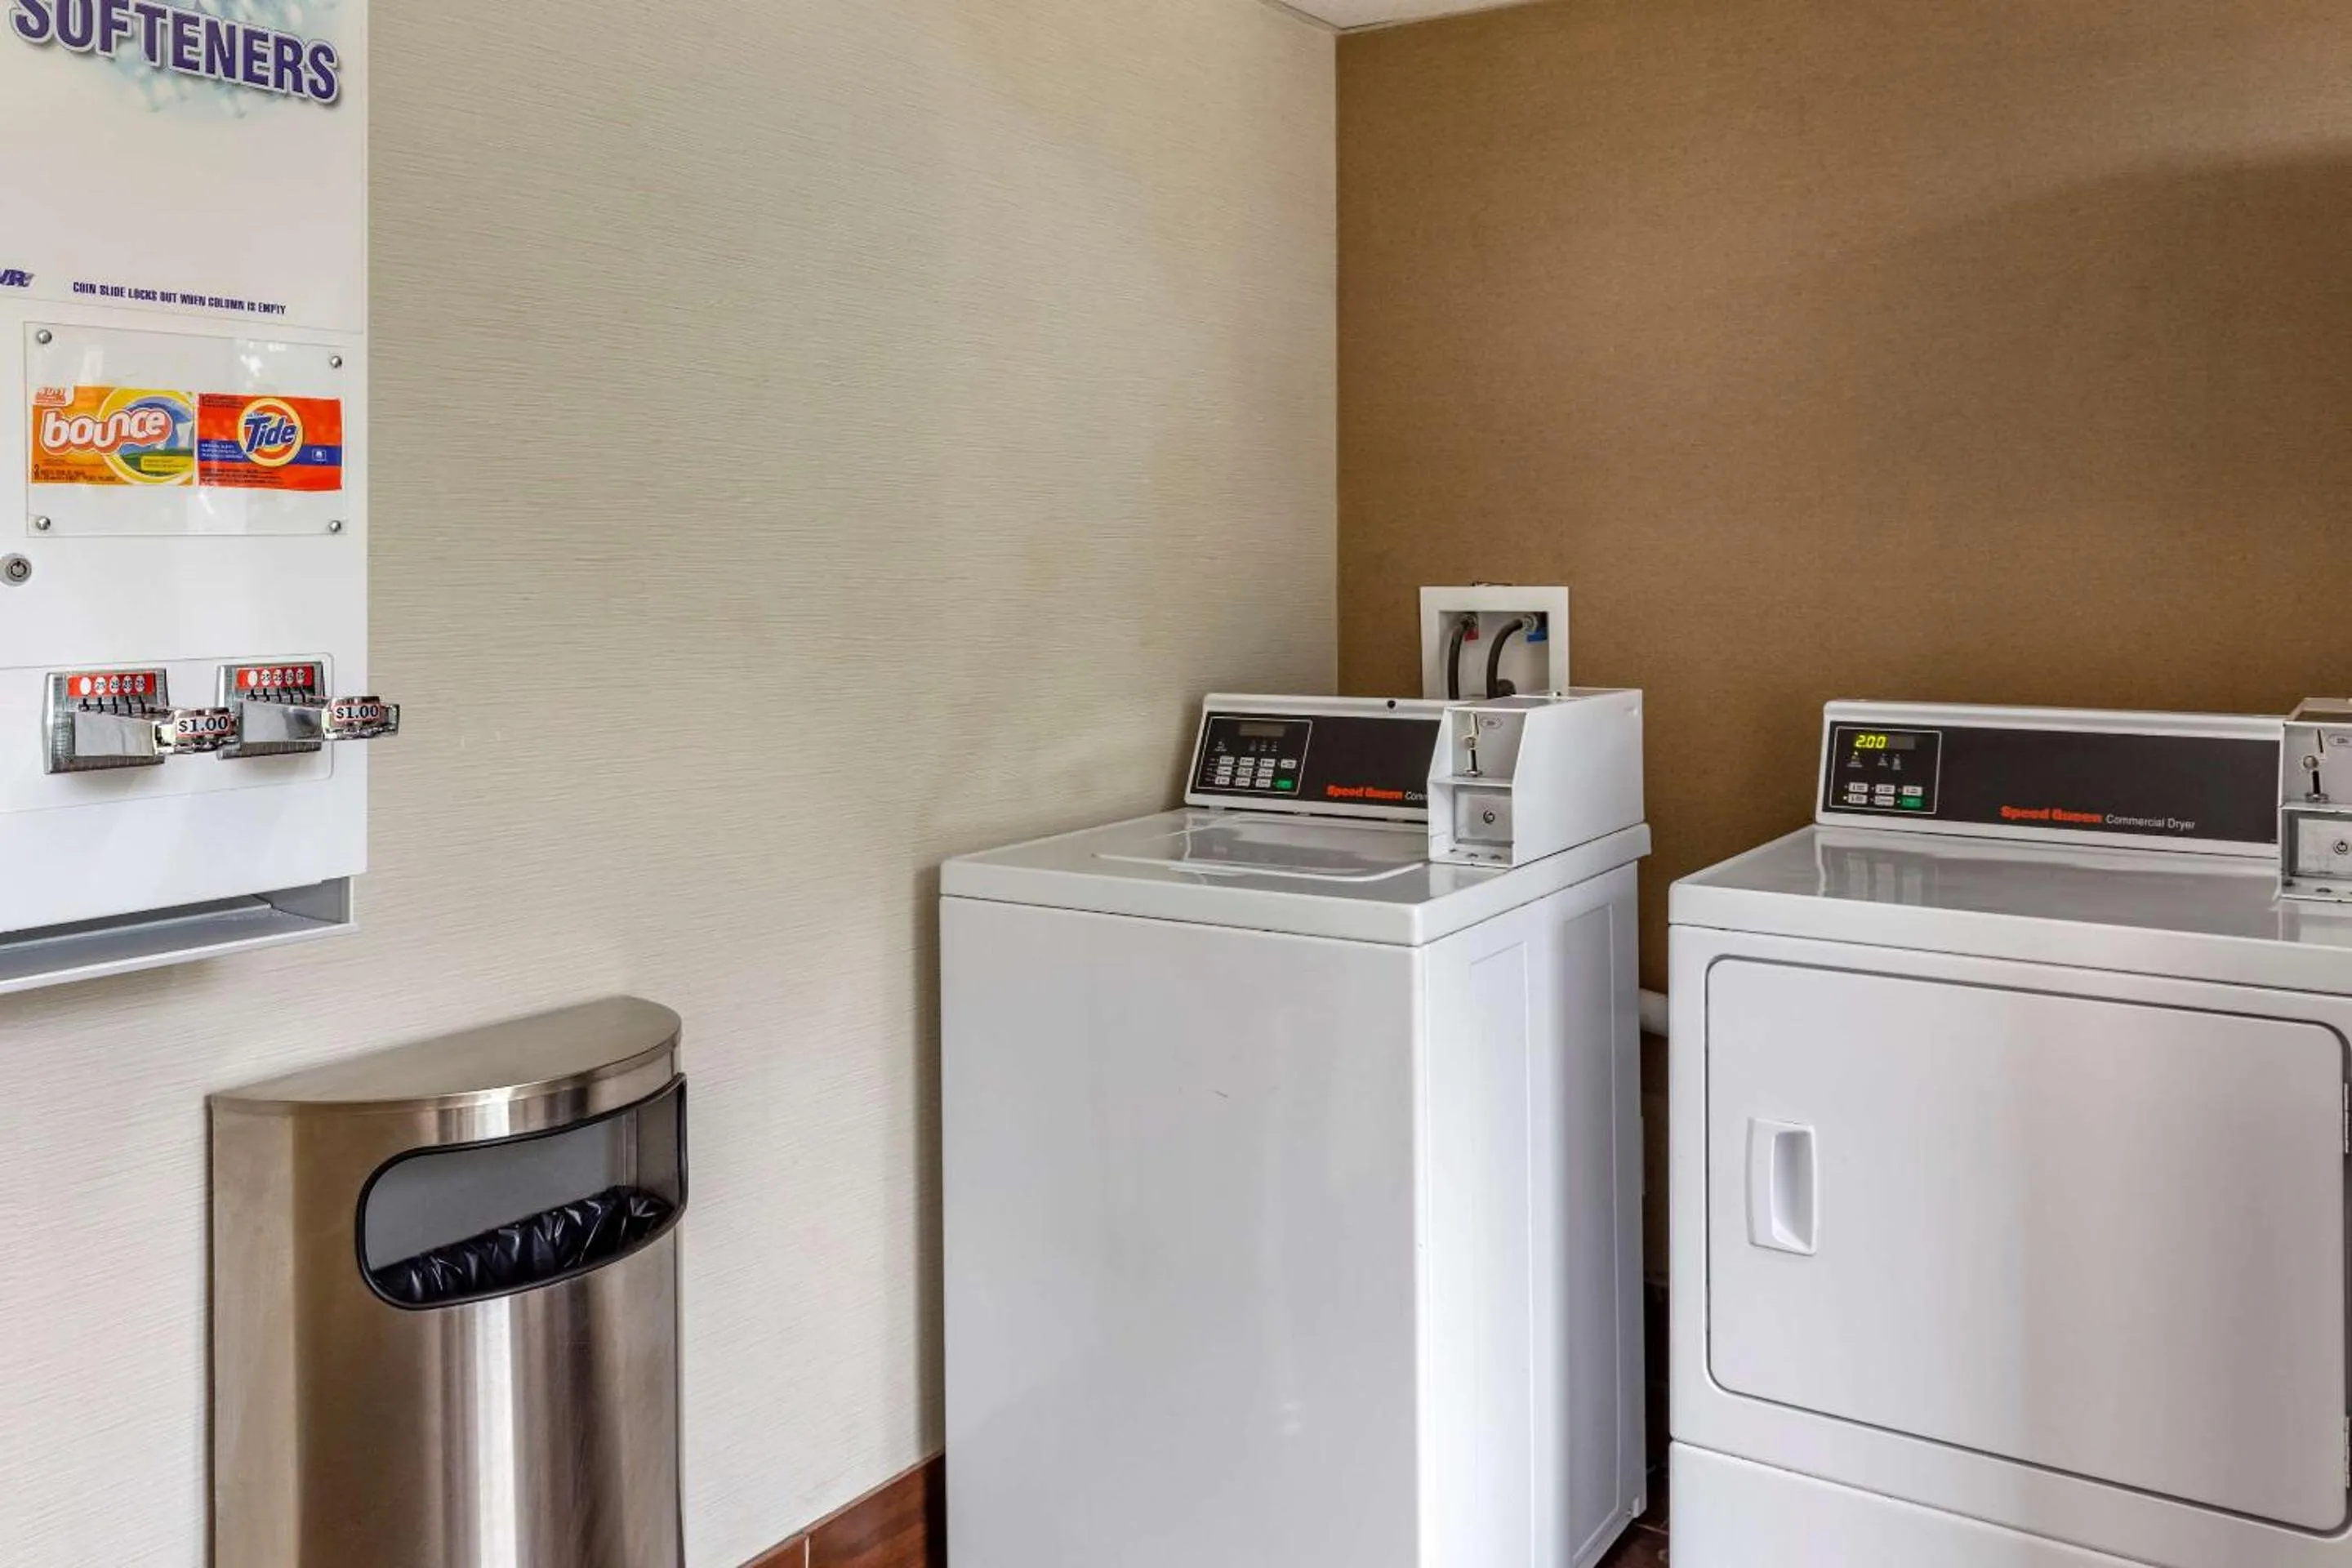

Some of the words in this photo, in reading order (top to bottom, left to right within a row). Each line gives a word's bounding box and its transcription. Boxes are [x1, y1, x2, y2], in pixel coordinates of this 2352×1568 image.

[11, 0, 340, 102] SOFTENERS
[73, 281, 96, 294] COIN
[100, 284, 127, 299] SLIDE
[127, 287, 158, 302] LOCKS
[159, 291, 177, 304] OUT
[180, 293, 205, 307] WHEN
[207, 296, 244, 311] COLUMN
[247, 301, 256, 312] IS
[258, 301, 287, 314] EMPTY
[42, 409, 167, 448] bounce
[244, 415, 298, 454] Tide
[177, 715, 229, 733] $1.00
[336, 704, 380, 719] $1.00
[2105, 813, 2166, 827] Commercial
[2167, 817, 2197, 832] Dryer
